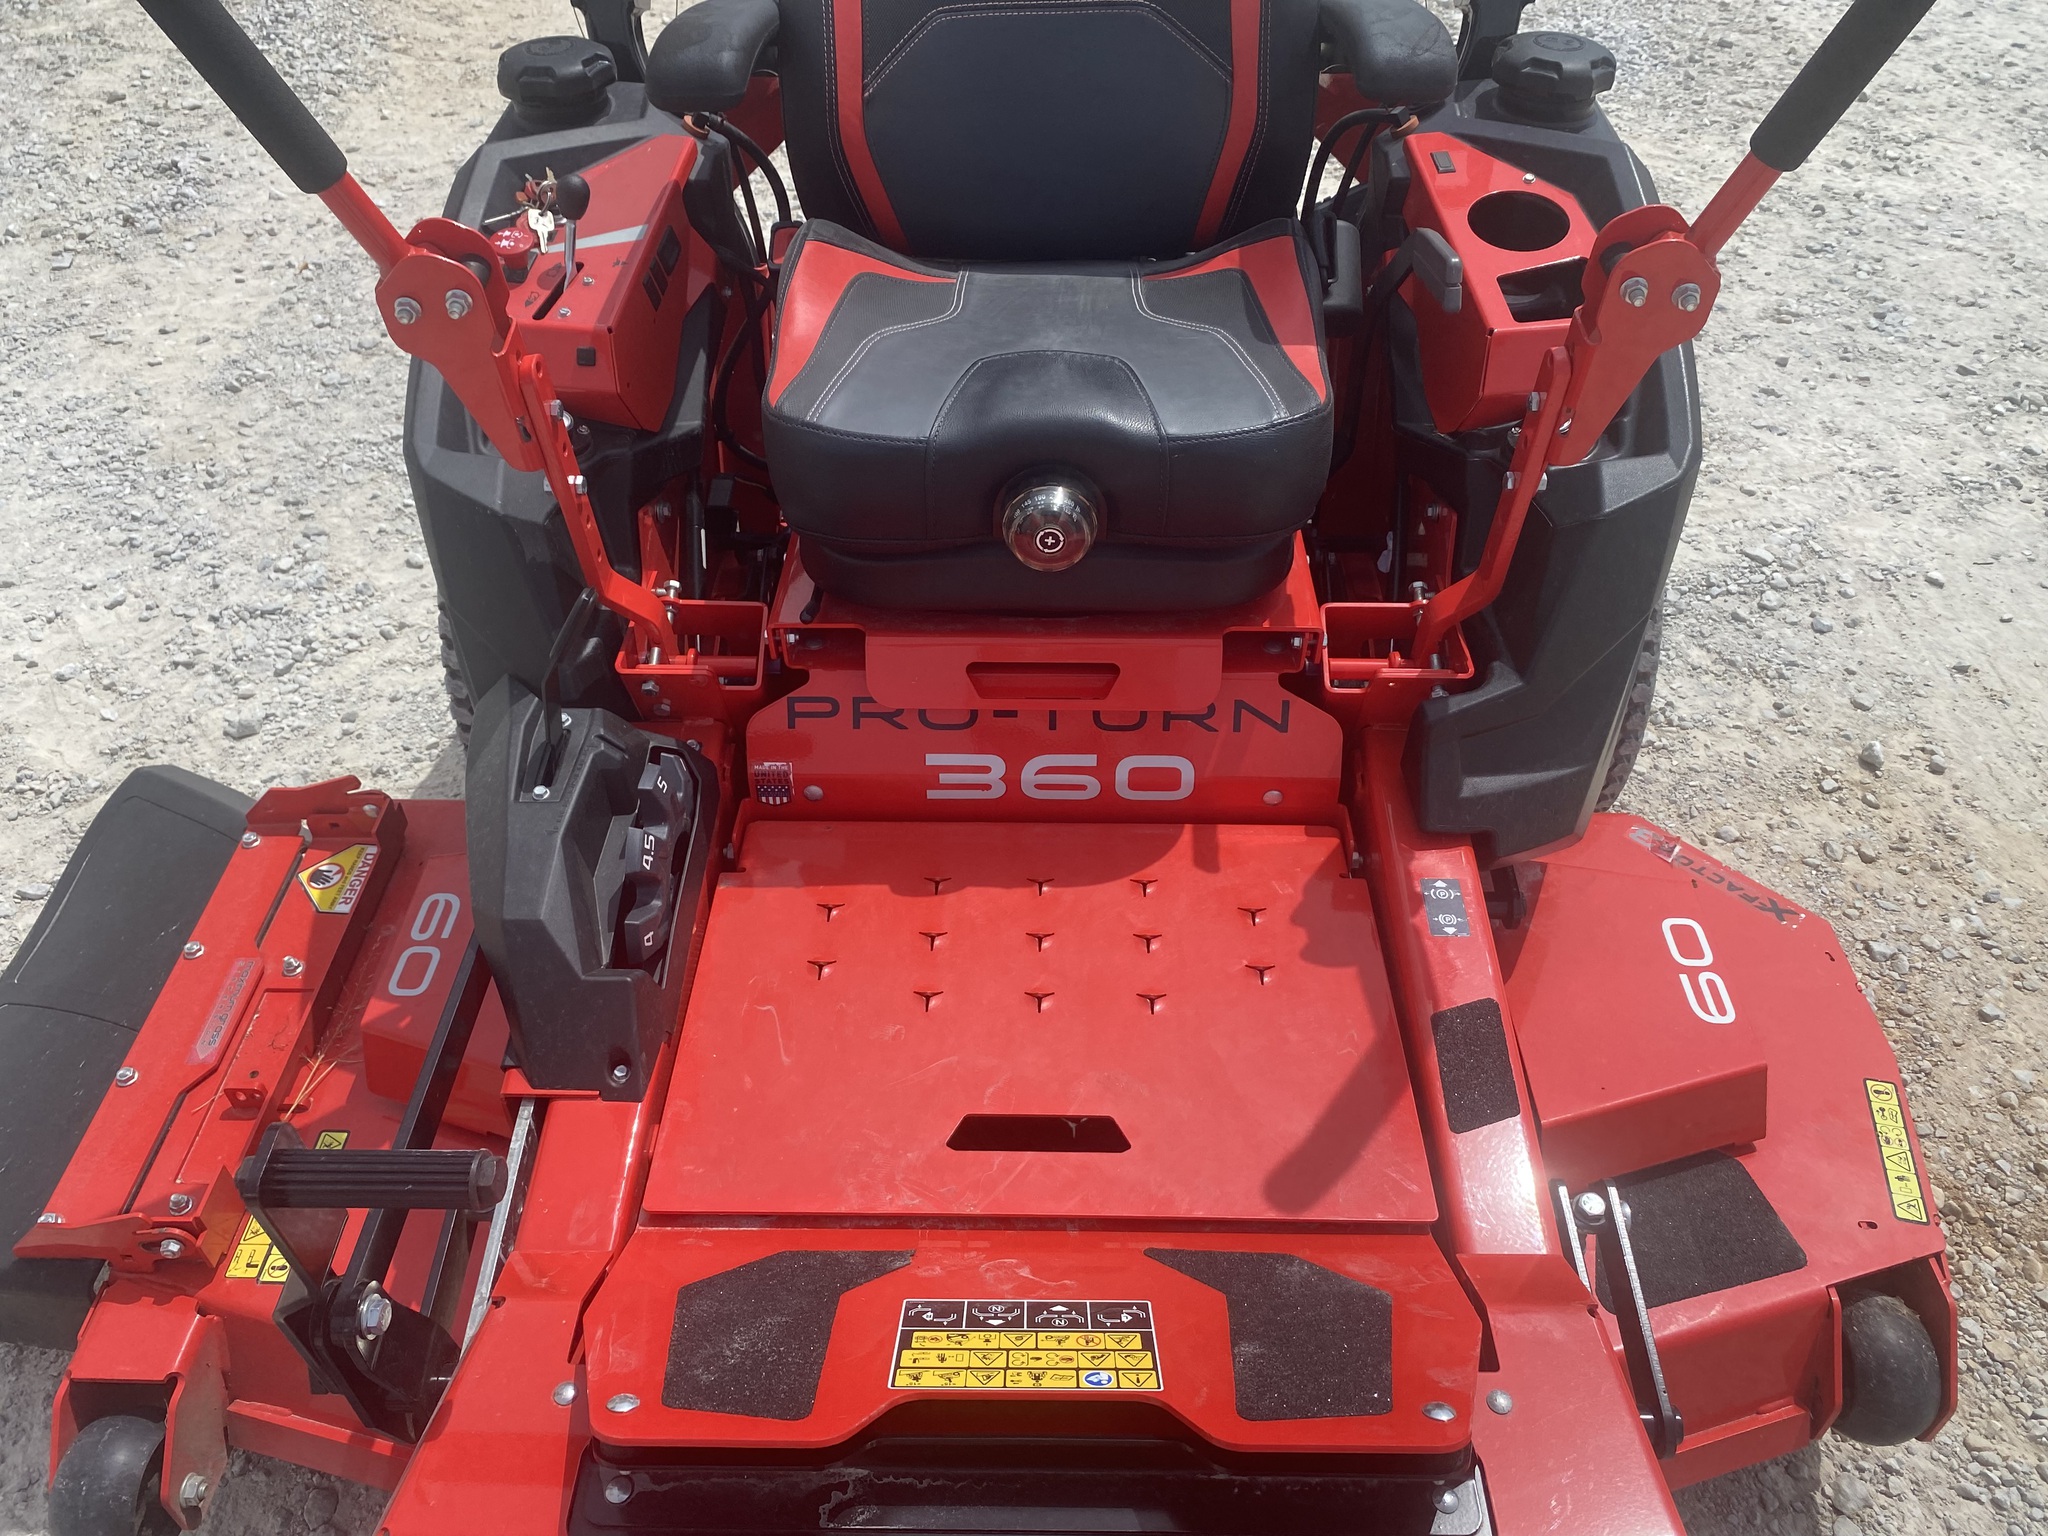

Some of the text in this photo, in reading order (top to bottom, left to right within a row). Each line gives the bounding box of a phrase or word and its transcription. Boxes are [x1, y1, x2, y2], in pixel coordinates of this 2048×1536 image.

[656, 776, 668, 793] 5
[925, 753, 1195, 800] 360
[643, 834, 655, 870] 4.5
[338, 853, 375, 905] DANGER
[388, 893, 460, 996] 60
[1661, 917, 1736, 1024] 60
